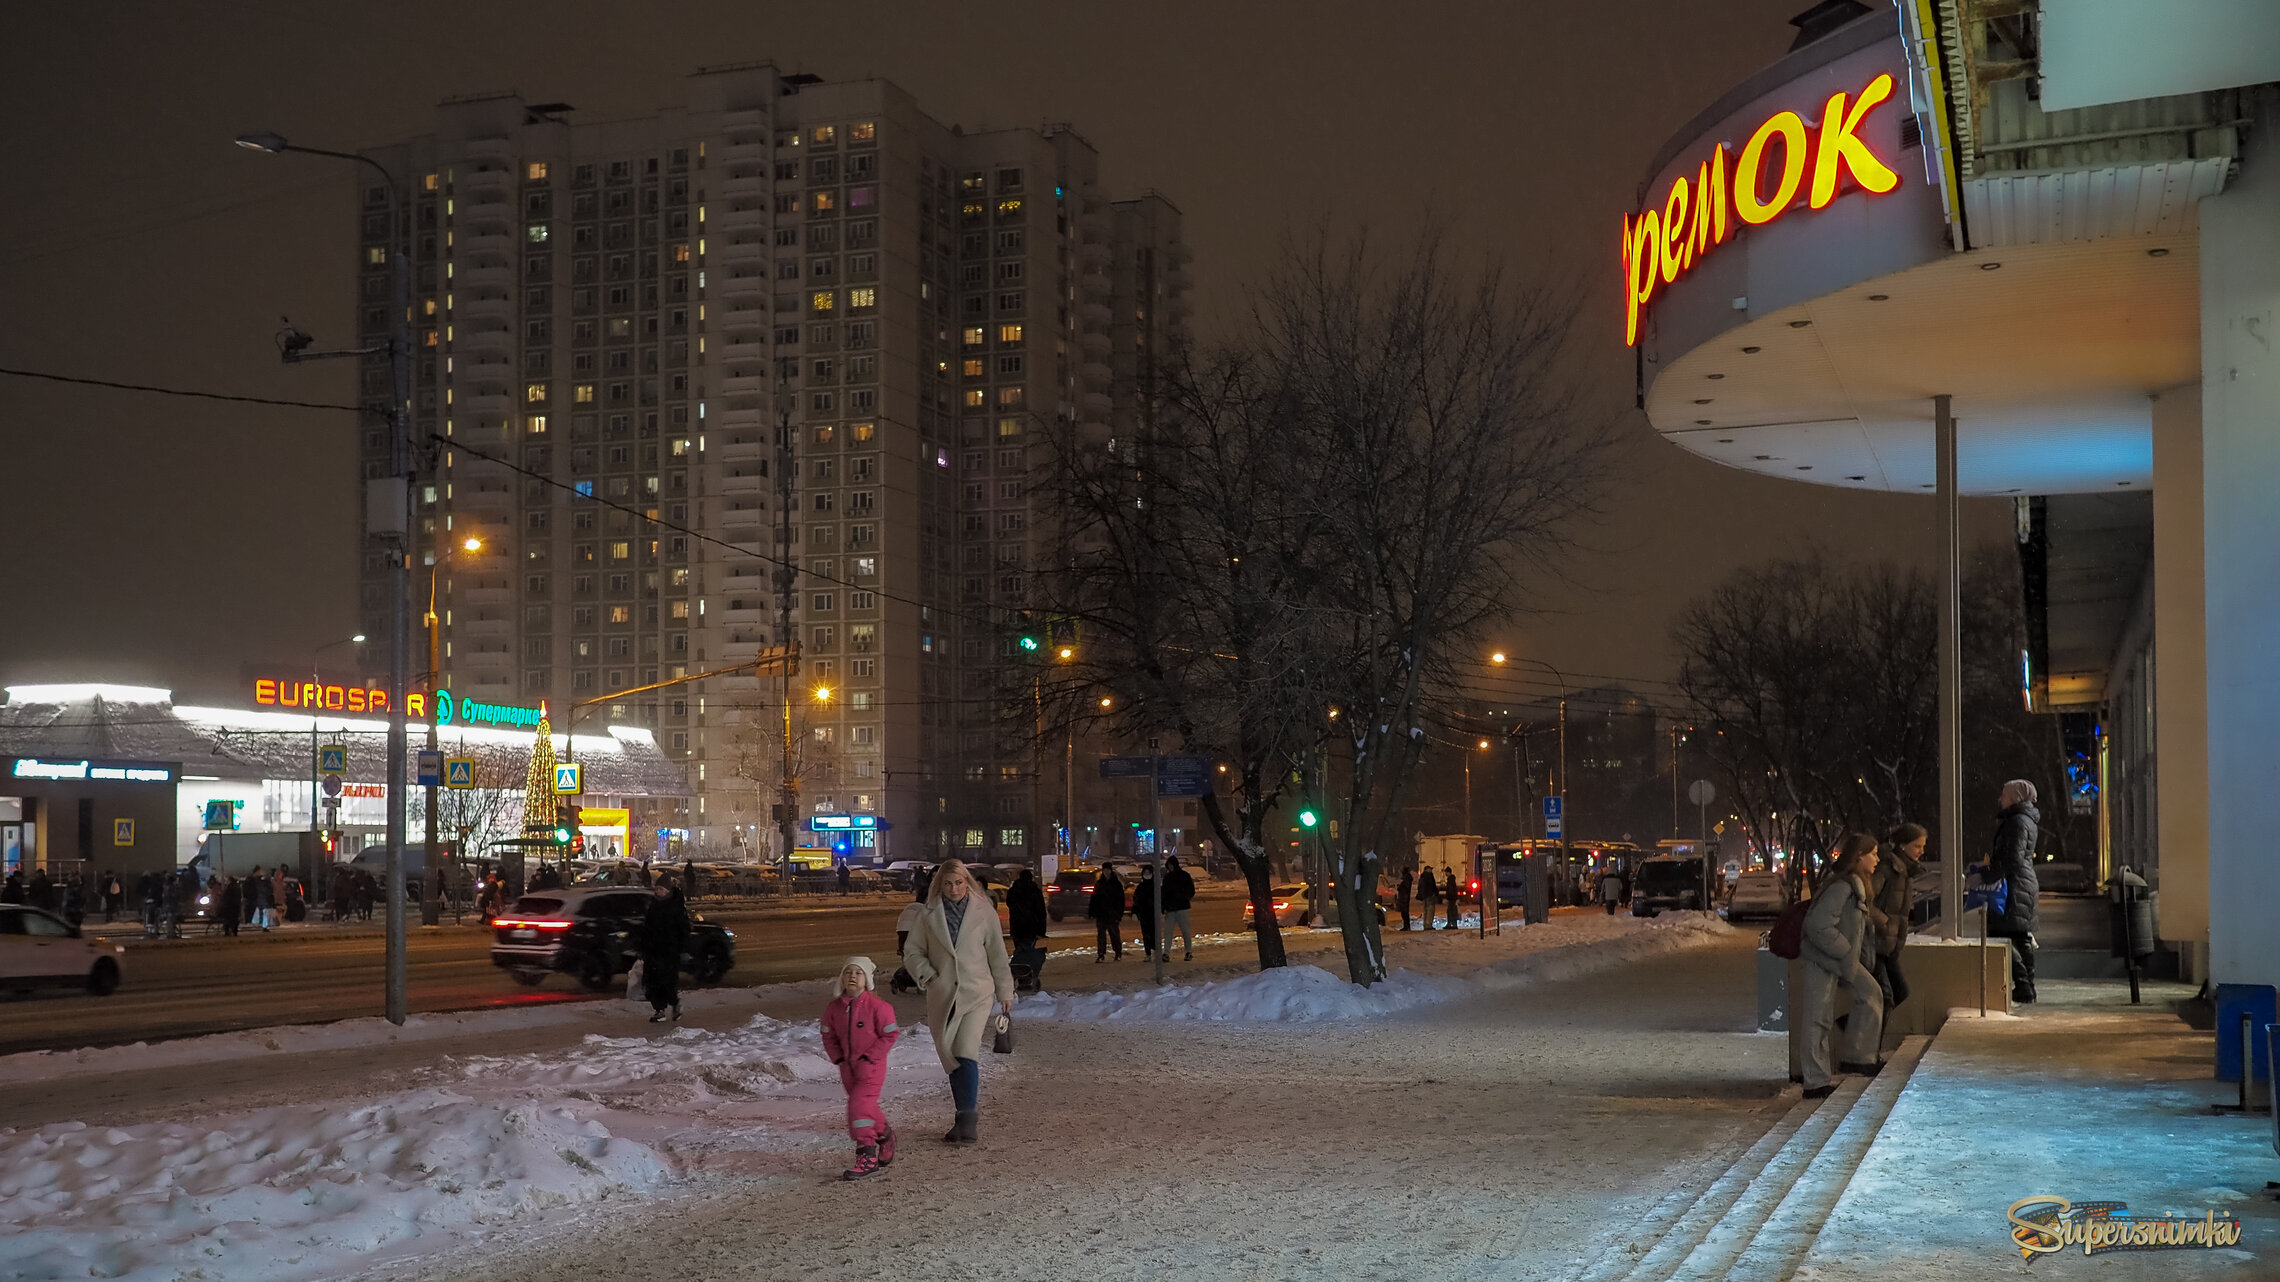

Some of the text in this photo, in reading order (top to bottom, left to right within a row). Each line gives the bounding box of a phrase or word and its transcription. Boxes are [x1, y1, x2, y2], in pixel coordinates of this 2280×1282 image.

[1623, 73, 1899, 346] ремок
[255, 679, 426, 717] EUROSPR
[460, 697, 542, 728] Супермарке
